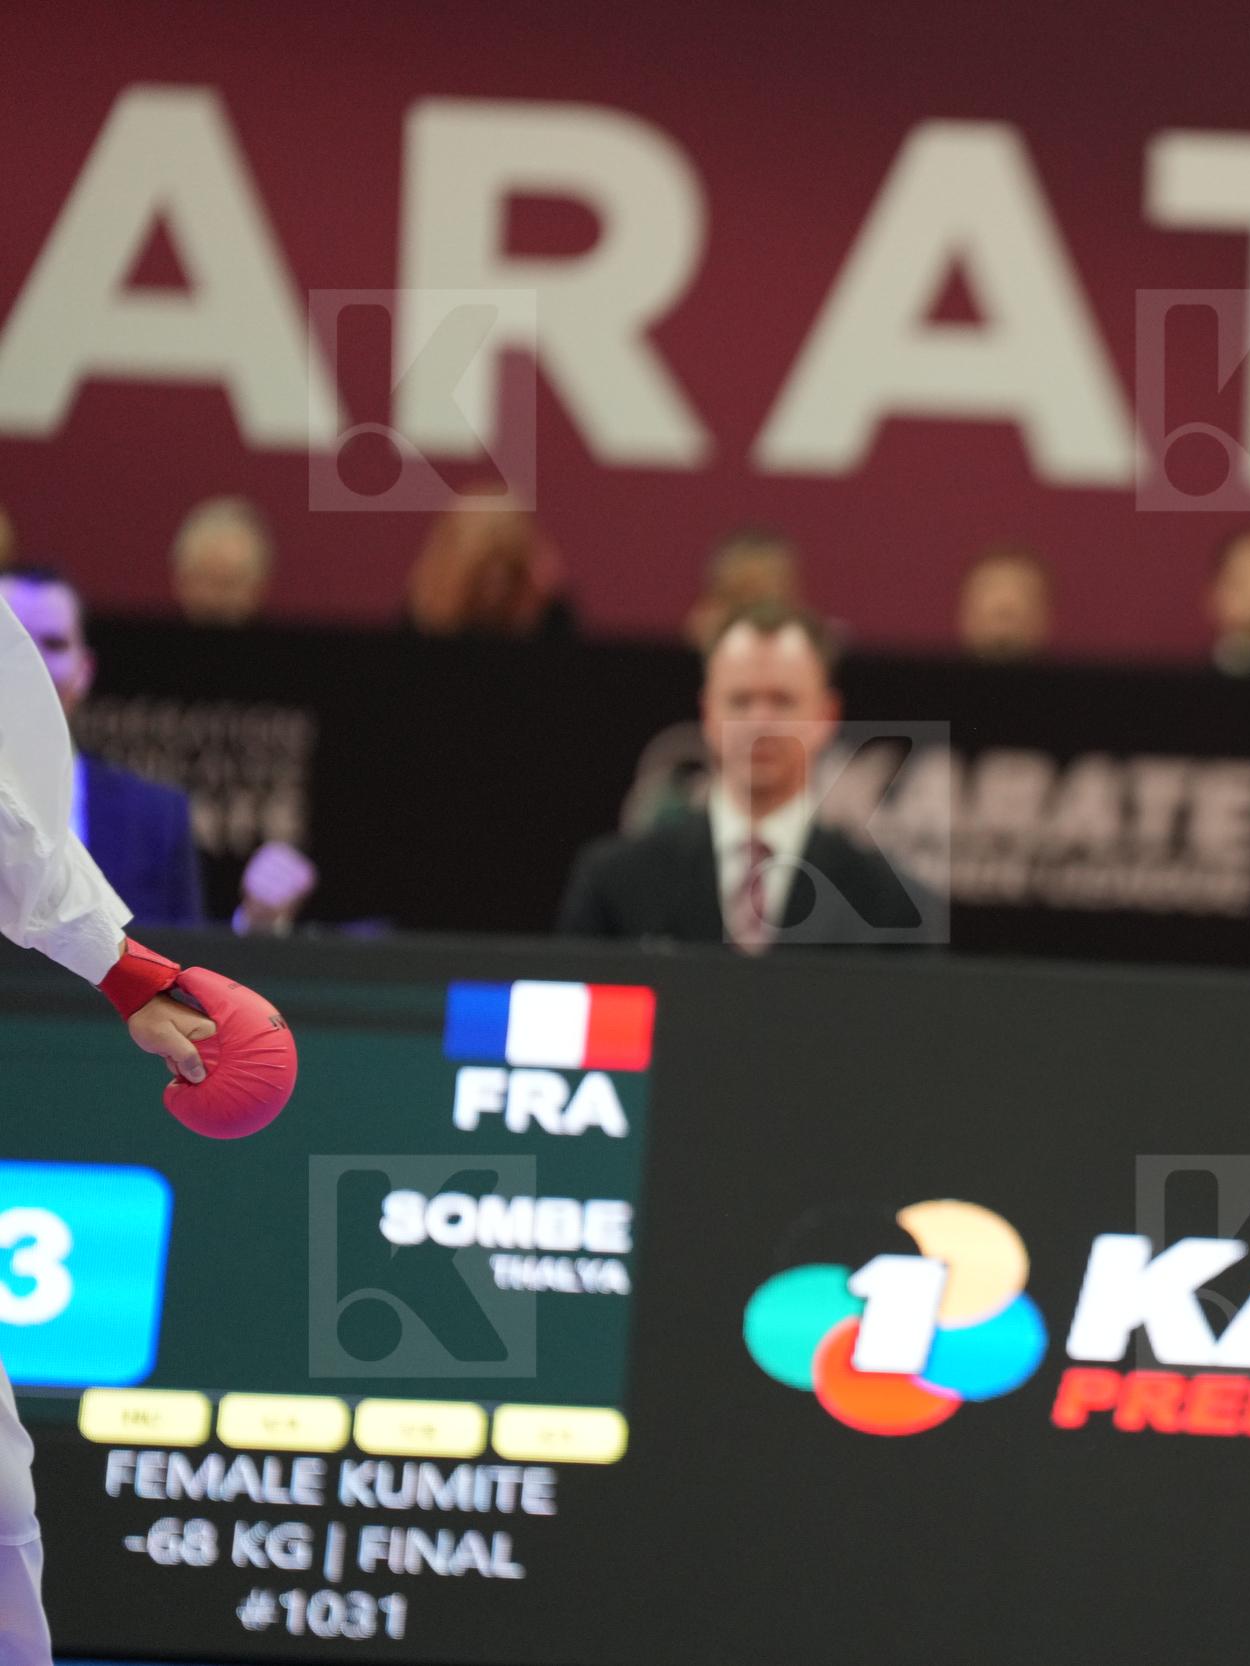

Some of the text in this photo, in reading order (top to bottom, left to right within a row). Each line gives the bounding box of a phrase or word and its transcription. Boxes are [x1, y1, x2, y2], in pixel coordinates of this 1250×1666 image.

[453, 1065, 630, 1138] FRA
[379, 1188, 633, 1254] SOMBE
[0, 1206, 73, 1326] 3
[847, 1253, 949, 1375] 1
[105, 1449, 558, 1516] FEMALE KUMITE
[123, 1517, 219, 1567] -68
[232, 1519, 314, 1570] KG
[357, 1524, 527, 1579] FINAL
[236, 1586, 408, 1641] #1031
